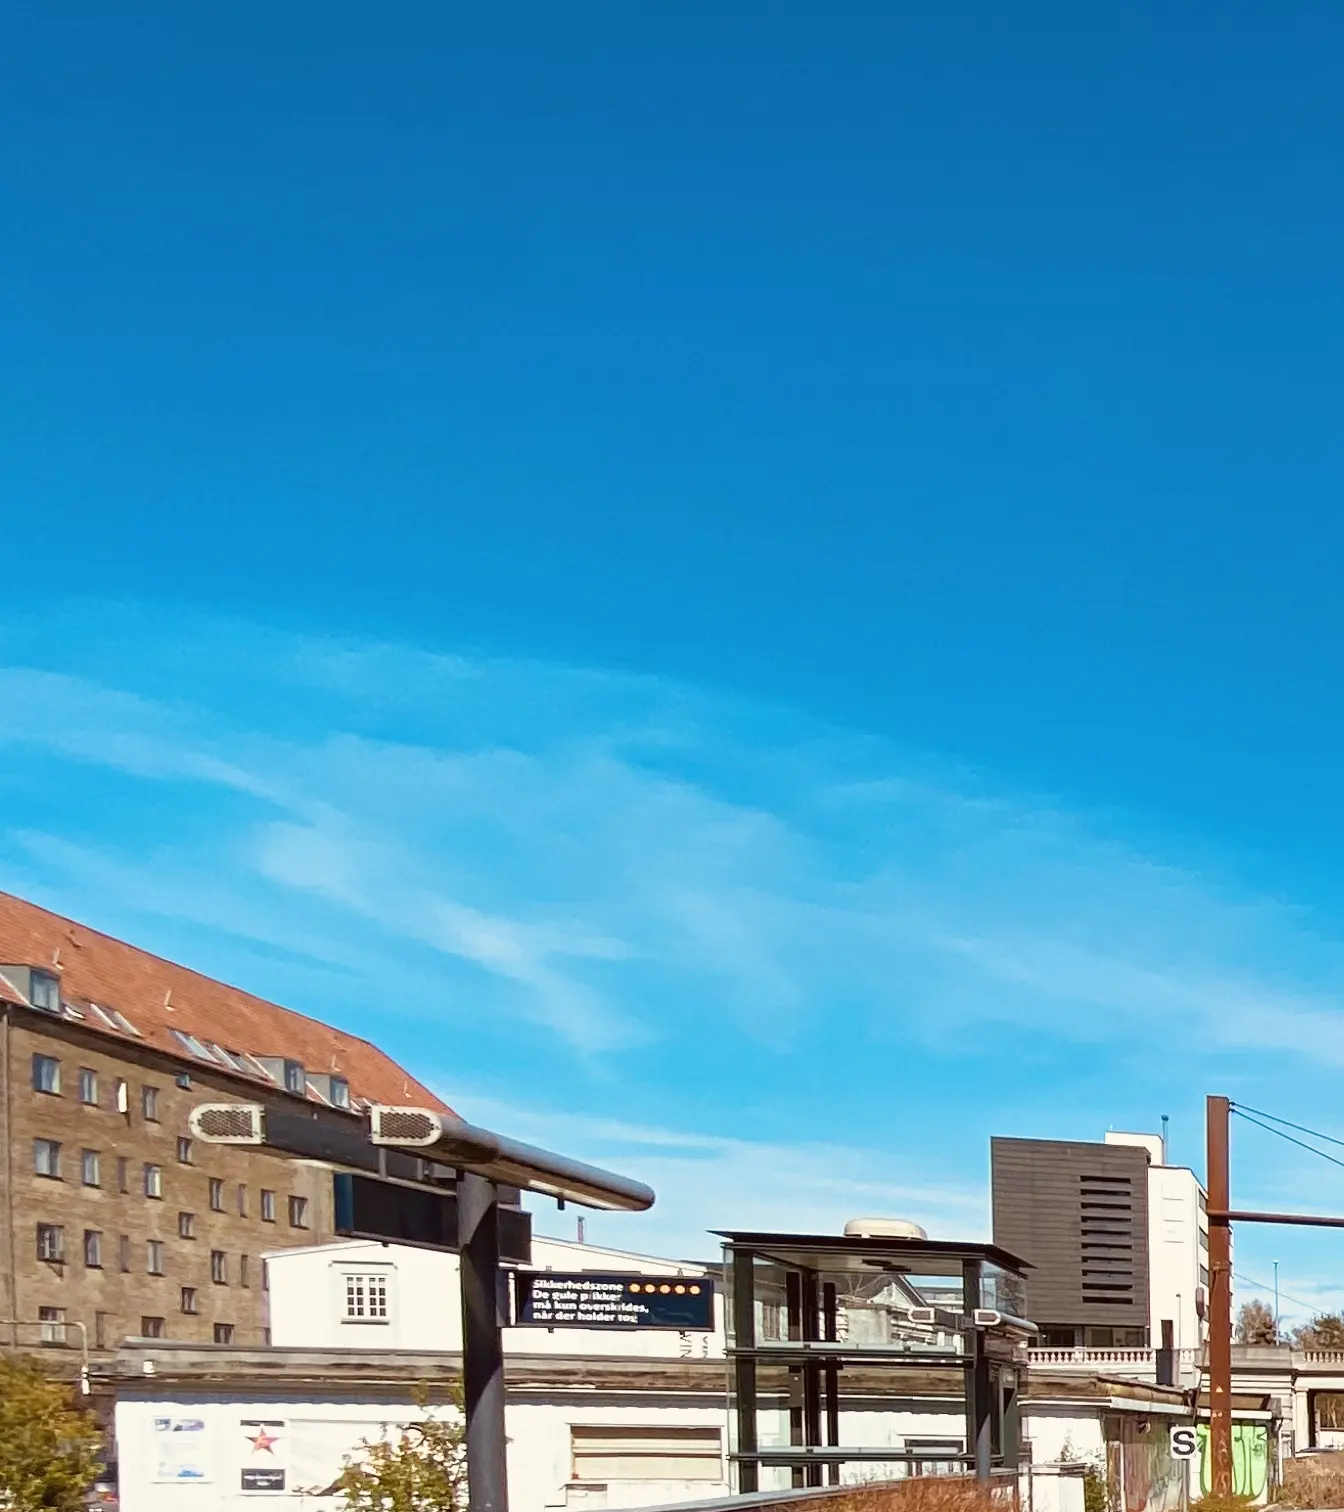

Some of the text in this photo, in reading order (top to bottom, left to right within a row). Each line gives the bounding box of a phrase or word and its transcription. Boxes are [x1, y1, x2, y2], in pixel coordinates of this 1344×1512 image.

[532, 1280, 624, 1291] Sikkerhedszone
[532, 1290, 622, 1301] De gule pikker
[532, 1300, 649, 1314] må kun overskides,
[554, 1311, 576, 1321] der
[577, 1312, 615, 1322] holder
[1173, 1430, 1195, 1455] S
